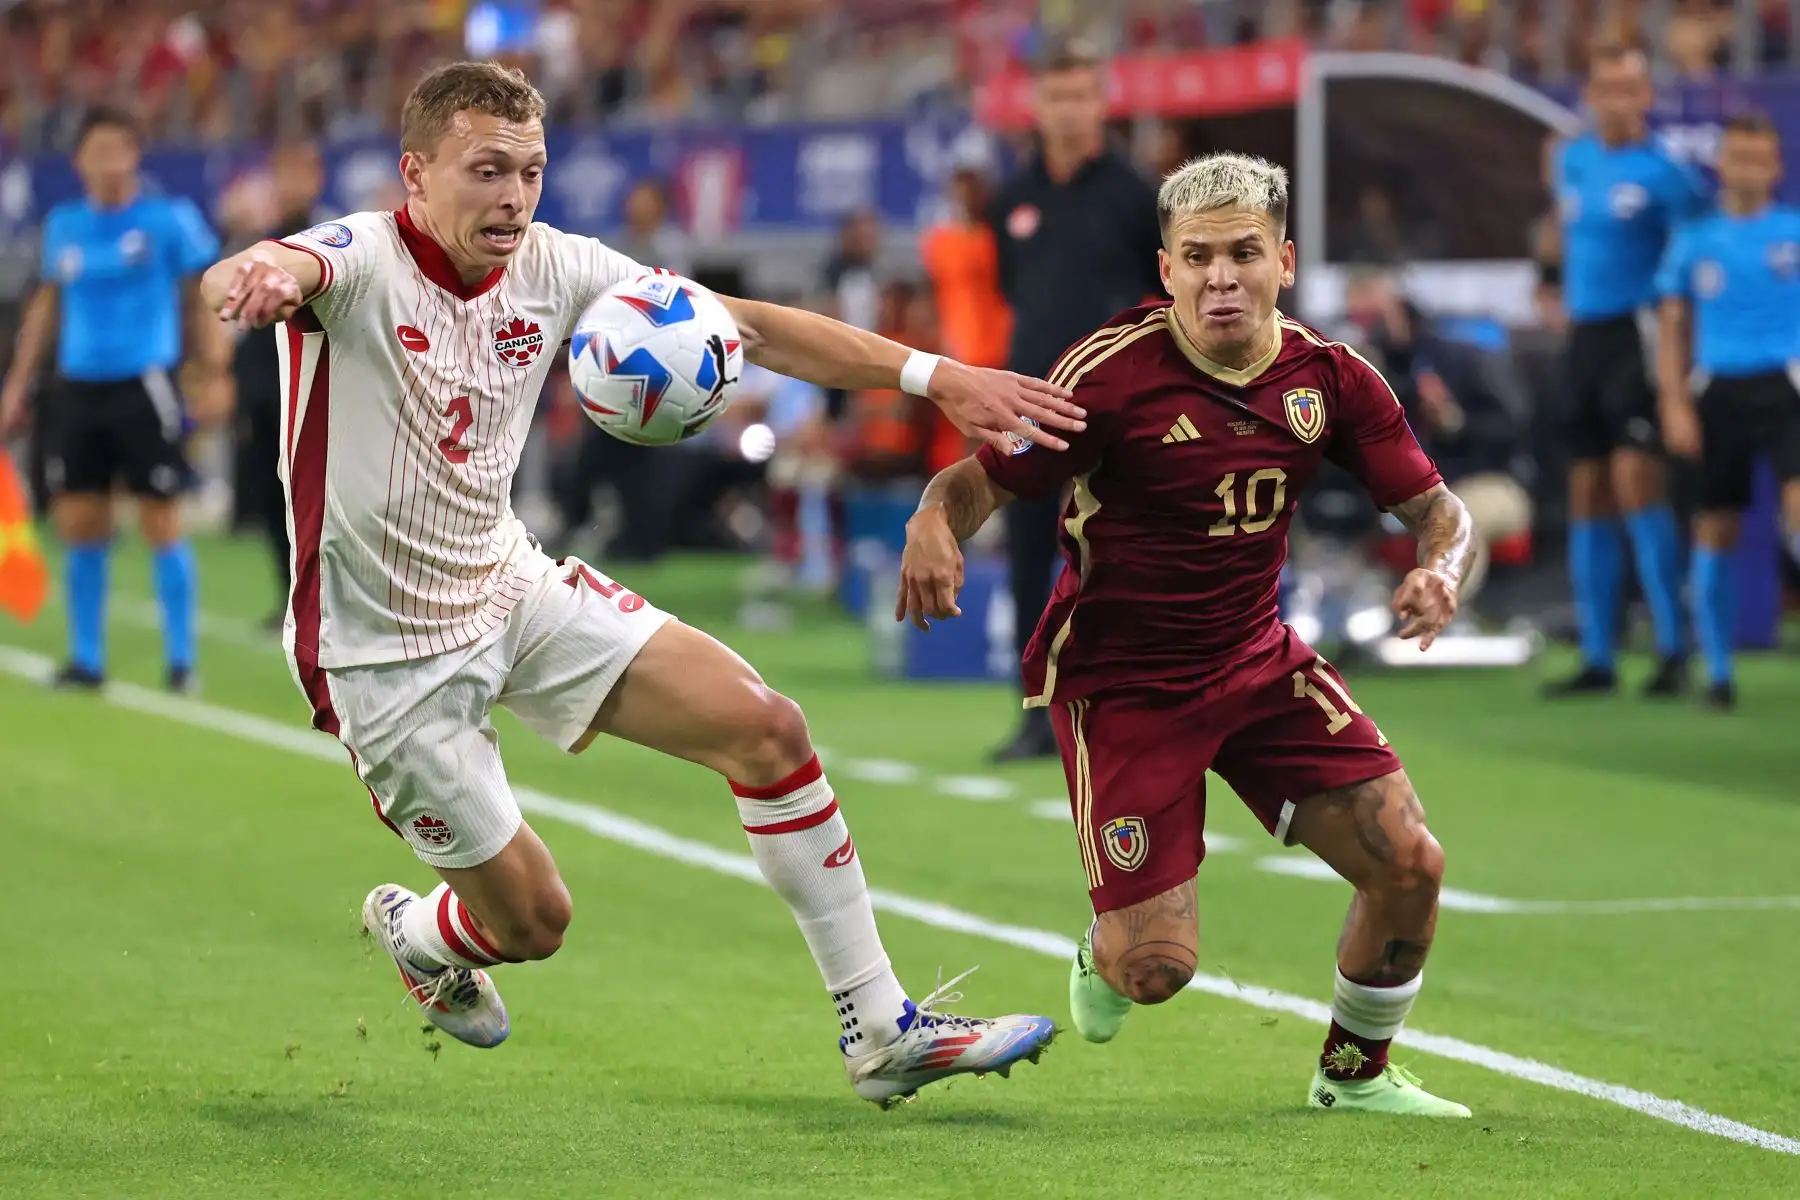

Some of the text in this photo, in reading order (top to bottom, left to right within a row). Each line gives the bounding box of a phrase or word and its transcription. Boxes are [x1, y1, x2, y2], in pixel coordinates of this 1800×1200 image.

[494, 333, 544, 351] CANADA
[438, 395, 474, 464] 2
[1208, 467, 1288, 537] 10
